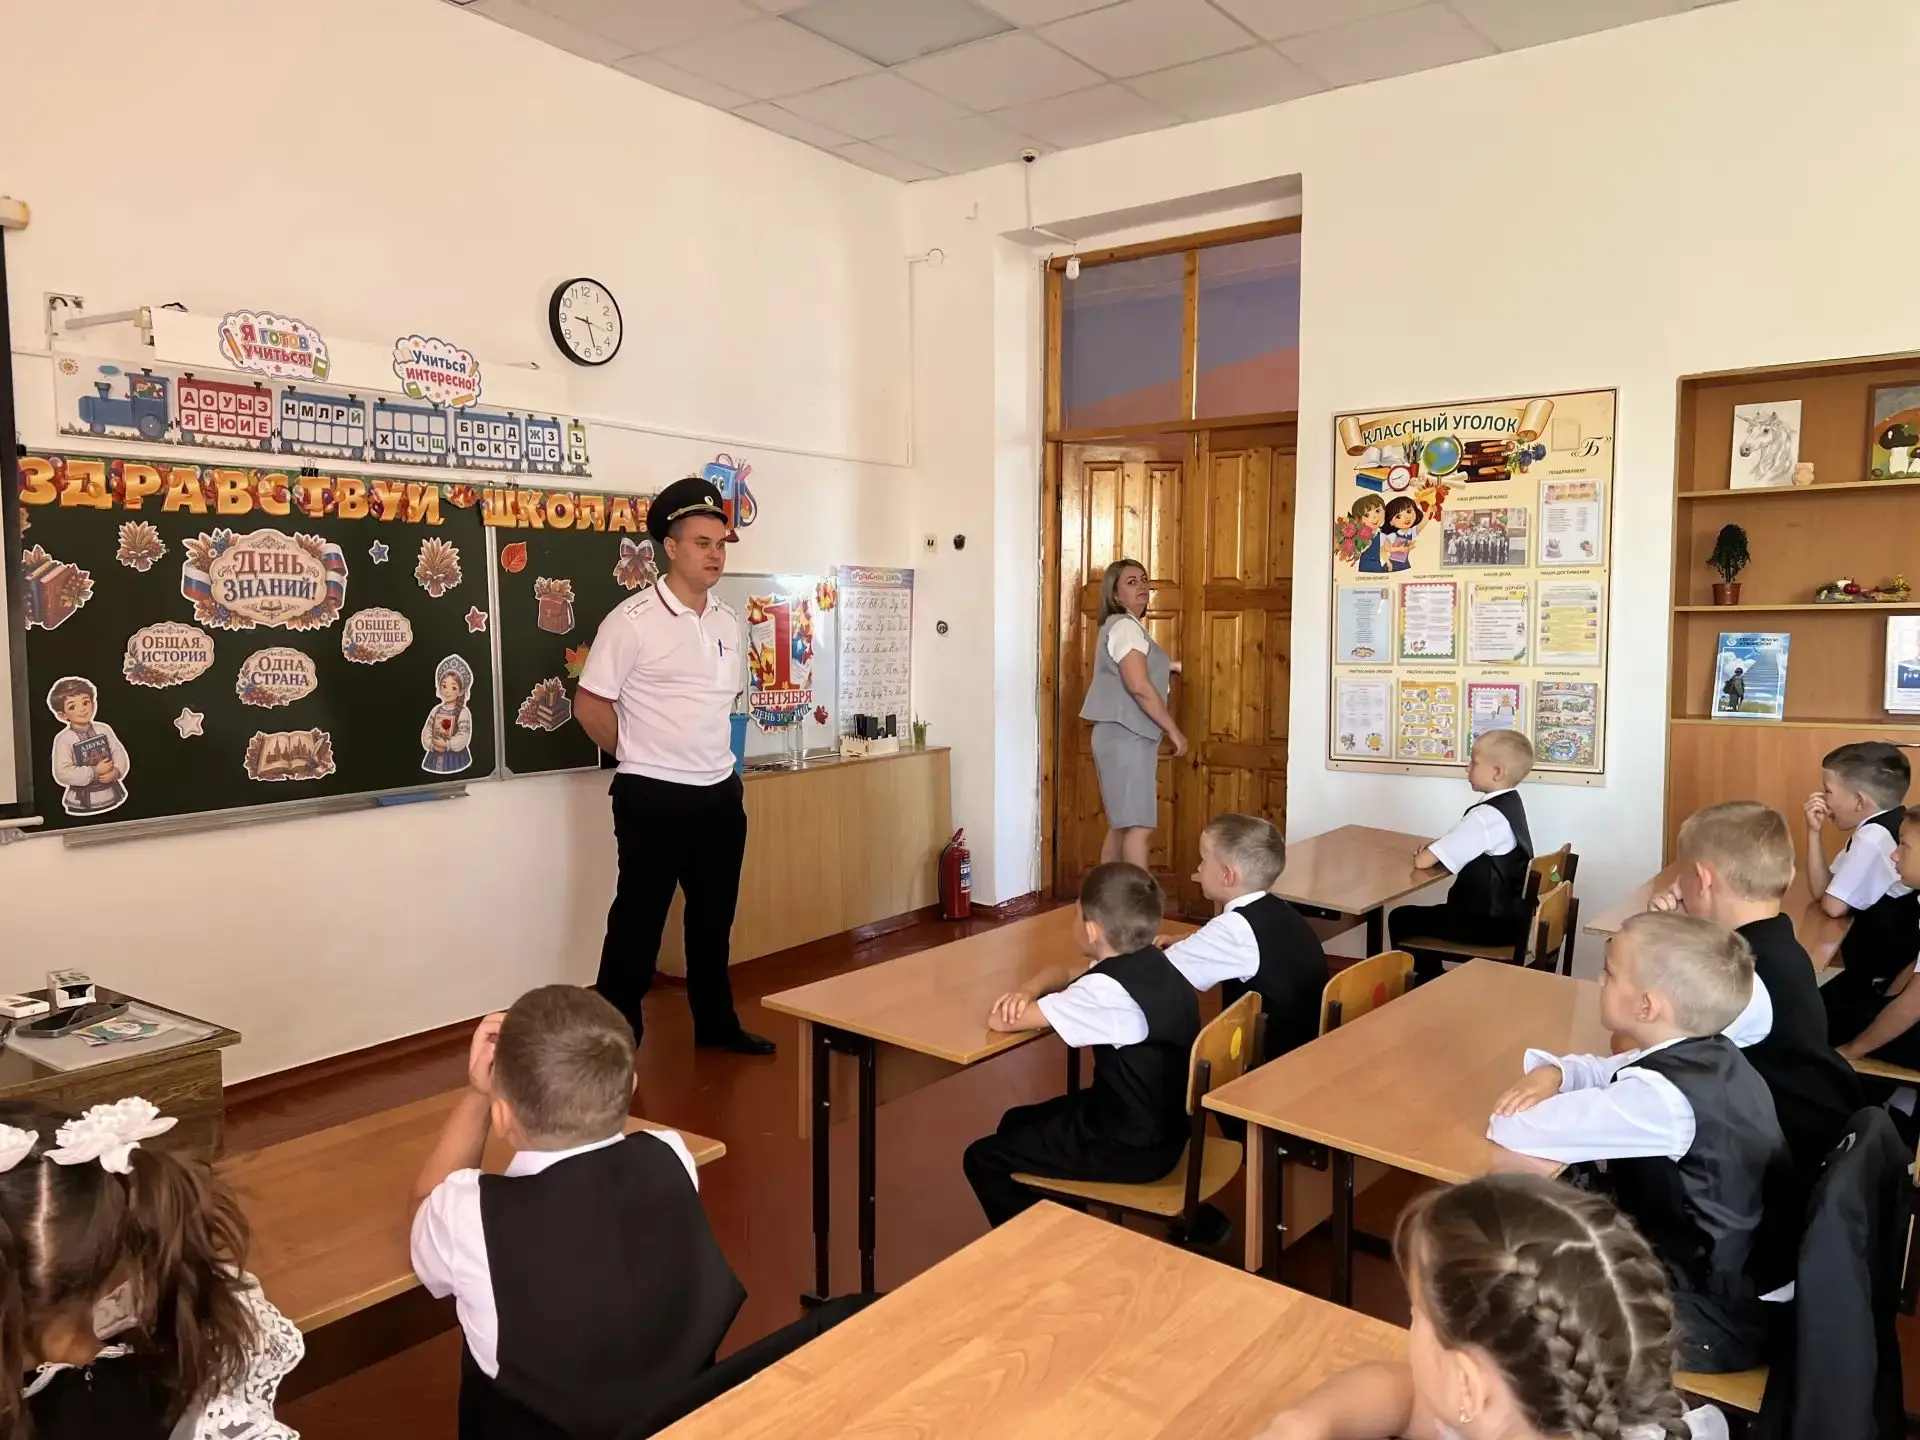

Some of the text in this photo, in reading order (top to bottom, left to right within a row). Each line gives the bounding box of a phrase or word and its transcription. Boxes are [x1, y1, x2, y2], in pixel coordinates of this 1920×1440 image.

[571, 288, 578, 299] 11
[581, 286, 591, 297] 12
[562, 297, 572, 308] 10
[560, 312, 567, 323] 9
[603, 306, 610, 316] 2
[606, 322, 613, 332] 3
[241, 323, 310, 351] Я ГОТОВ
[564, 329, 572, 340] 8
[573, 341, 580, 351] 7
[603, 337, 610, 347] 4
[241, 344, 314, 368] УЧИТЬСЯ!
[584, 348, 592, 358] 6
[596, 345, 603, 356] 5
[413, 350, 466, 374] Учиться
[406, 367, 476, 392] интересно!
[1363, 412, 1518, 446] КЛАССНЫЙ УГОЛОК
[482, 487, 648, 533] ШКОЛА!
[232, 550, 304, 579] ДЕНЬ
[223, 576, 318, 602] ЗНАНИЙ!
[355, 618, 401, 633] ОБЩЕЕ
[142, 635, 201, 650] ОБЩАЯ
[354, 631, 408, 645] БУДУЩЕЕ
[763, 602, 801, 691] 1
[141, 650, 207, 663] ИСТОРИЯ
[257, 655, 305, 673] ОДНА
[252, 672, 309, 687] СТРАНА
[750, 690, 813, 706] СЕНТЯБРЯ
[754, 708, 776, 722] ДЕНЬ
